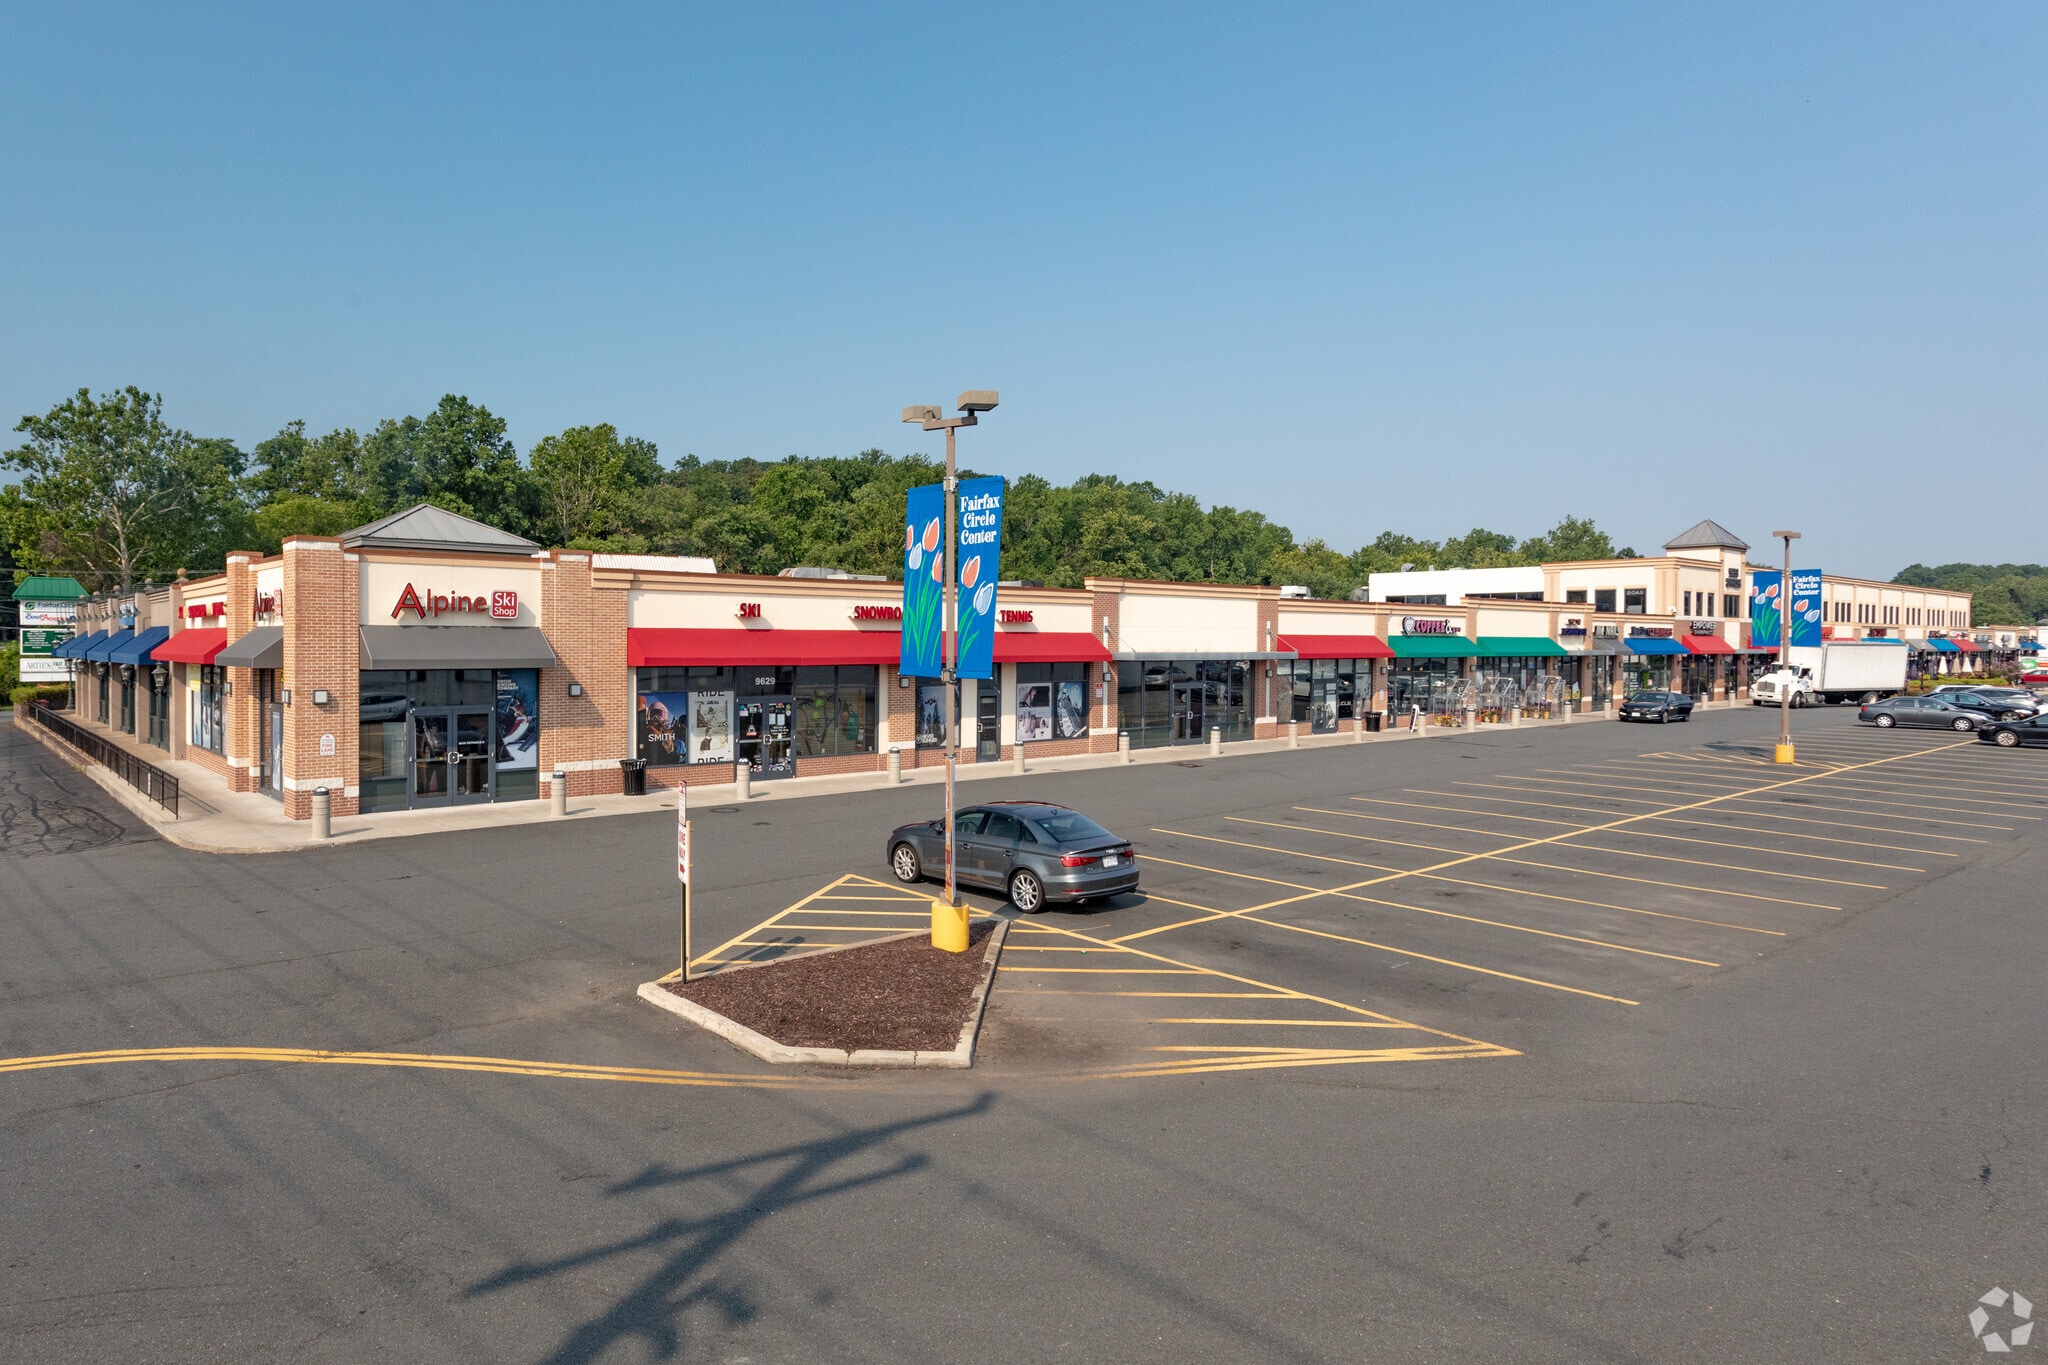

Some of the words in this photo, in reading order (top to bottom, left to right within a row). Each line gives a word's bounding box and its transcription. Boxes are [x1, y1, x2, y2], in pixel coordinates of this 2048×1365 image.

[960, 493, 1001, 513] Fairfax
[963, 510, 996, 529] Circle
[960, 529, 997, 545] Center
[1793, 575, 1820, 583] Fairfax
[494, 592, 515, 607] Ski
[1793, 588, 1820, 596] Center
[390, 582, 488, 619] Alpine
[494, 606, 515, 617] Shop
[739, 602, 762, 618] SKI
[853, 605, 903, 620] SNOWBO
[1000, 610, 1034, 623] TENNIS
[1415, 619, 1446, 634] COFFEE
[1692, 621, 1717, 630] EMPOWER
[755, 677, 776, 685] 9629
[648, 733, 676, 742] SMITH
